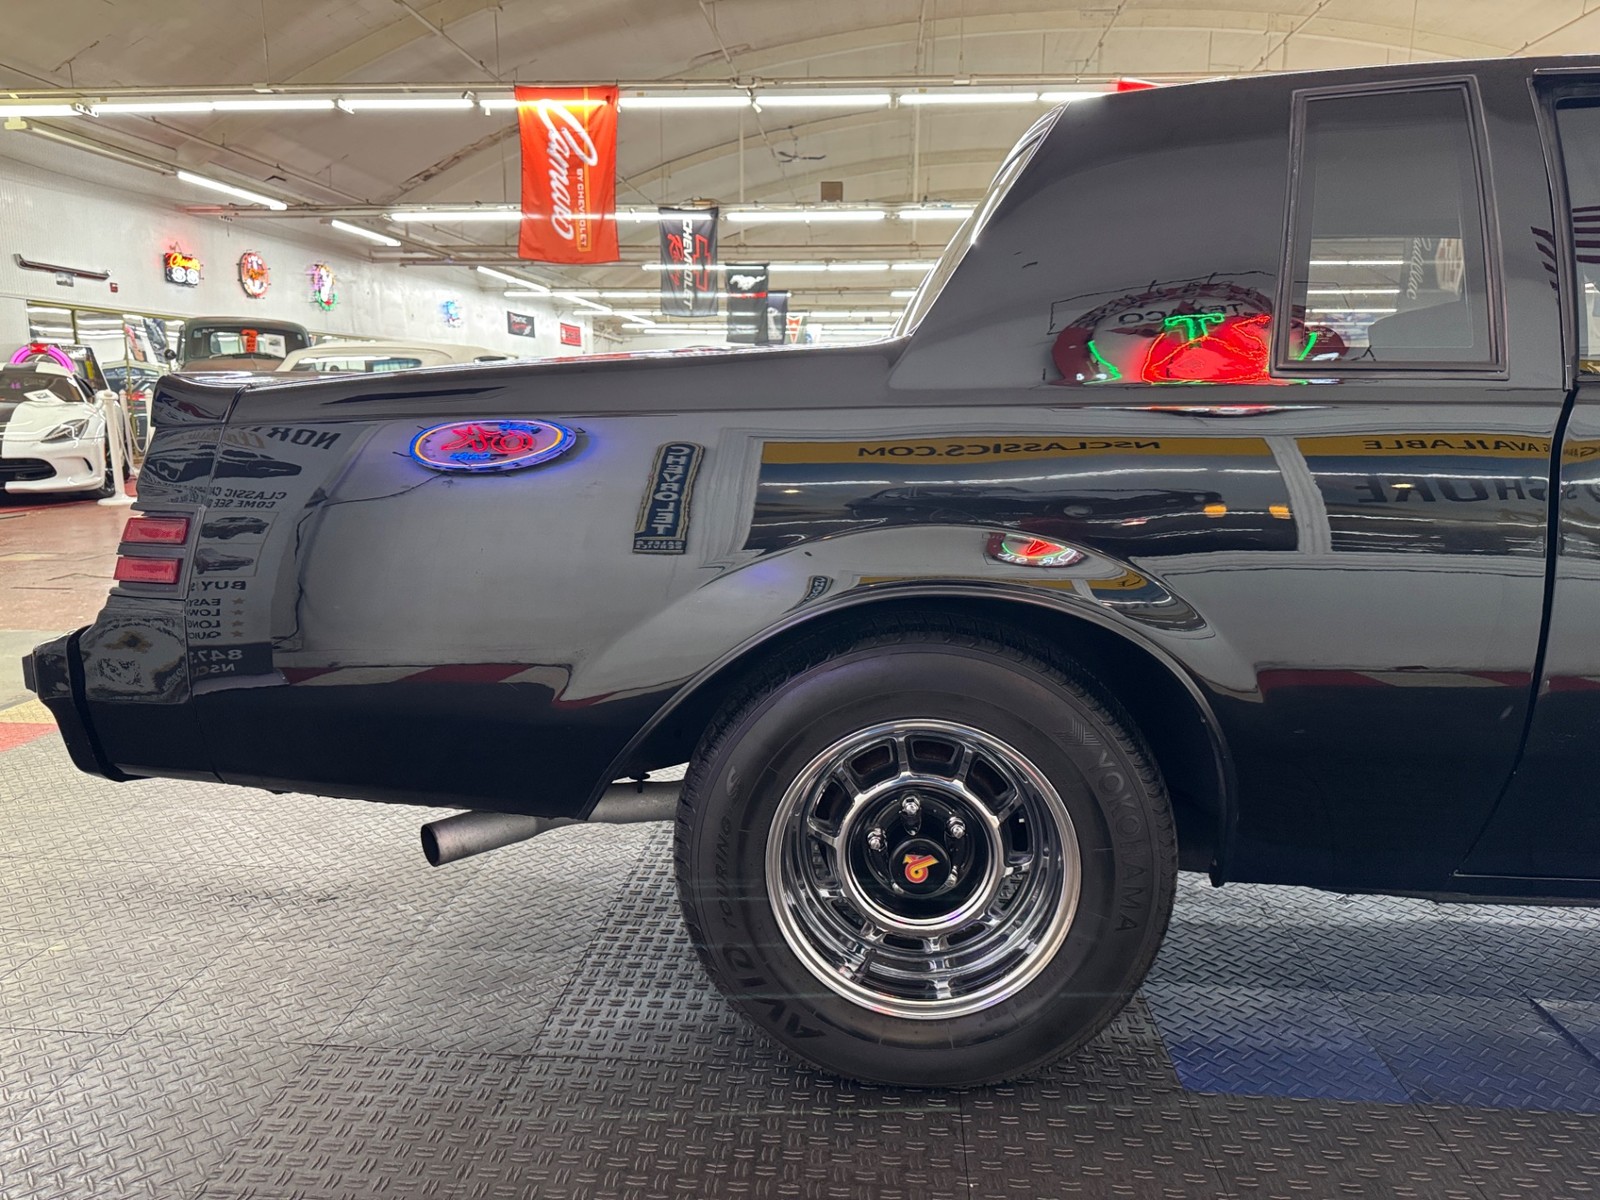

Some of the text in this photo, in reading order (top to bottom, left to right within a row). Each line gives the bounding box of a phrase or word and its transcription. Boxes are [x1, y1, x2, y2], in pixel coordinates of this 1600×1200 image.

[537, 98, 598, 241] Camaro
[576, 183, 588, 247] CHEVOLET
[713, 816, 738, 930] TOURING
[1088, 748, 1149, 933] YOKOHAMA
[721, 942, 827, 1040] AVID
